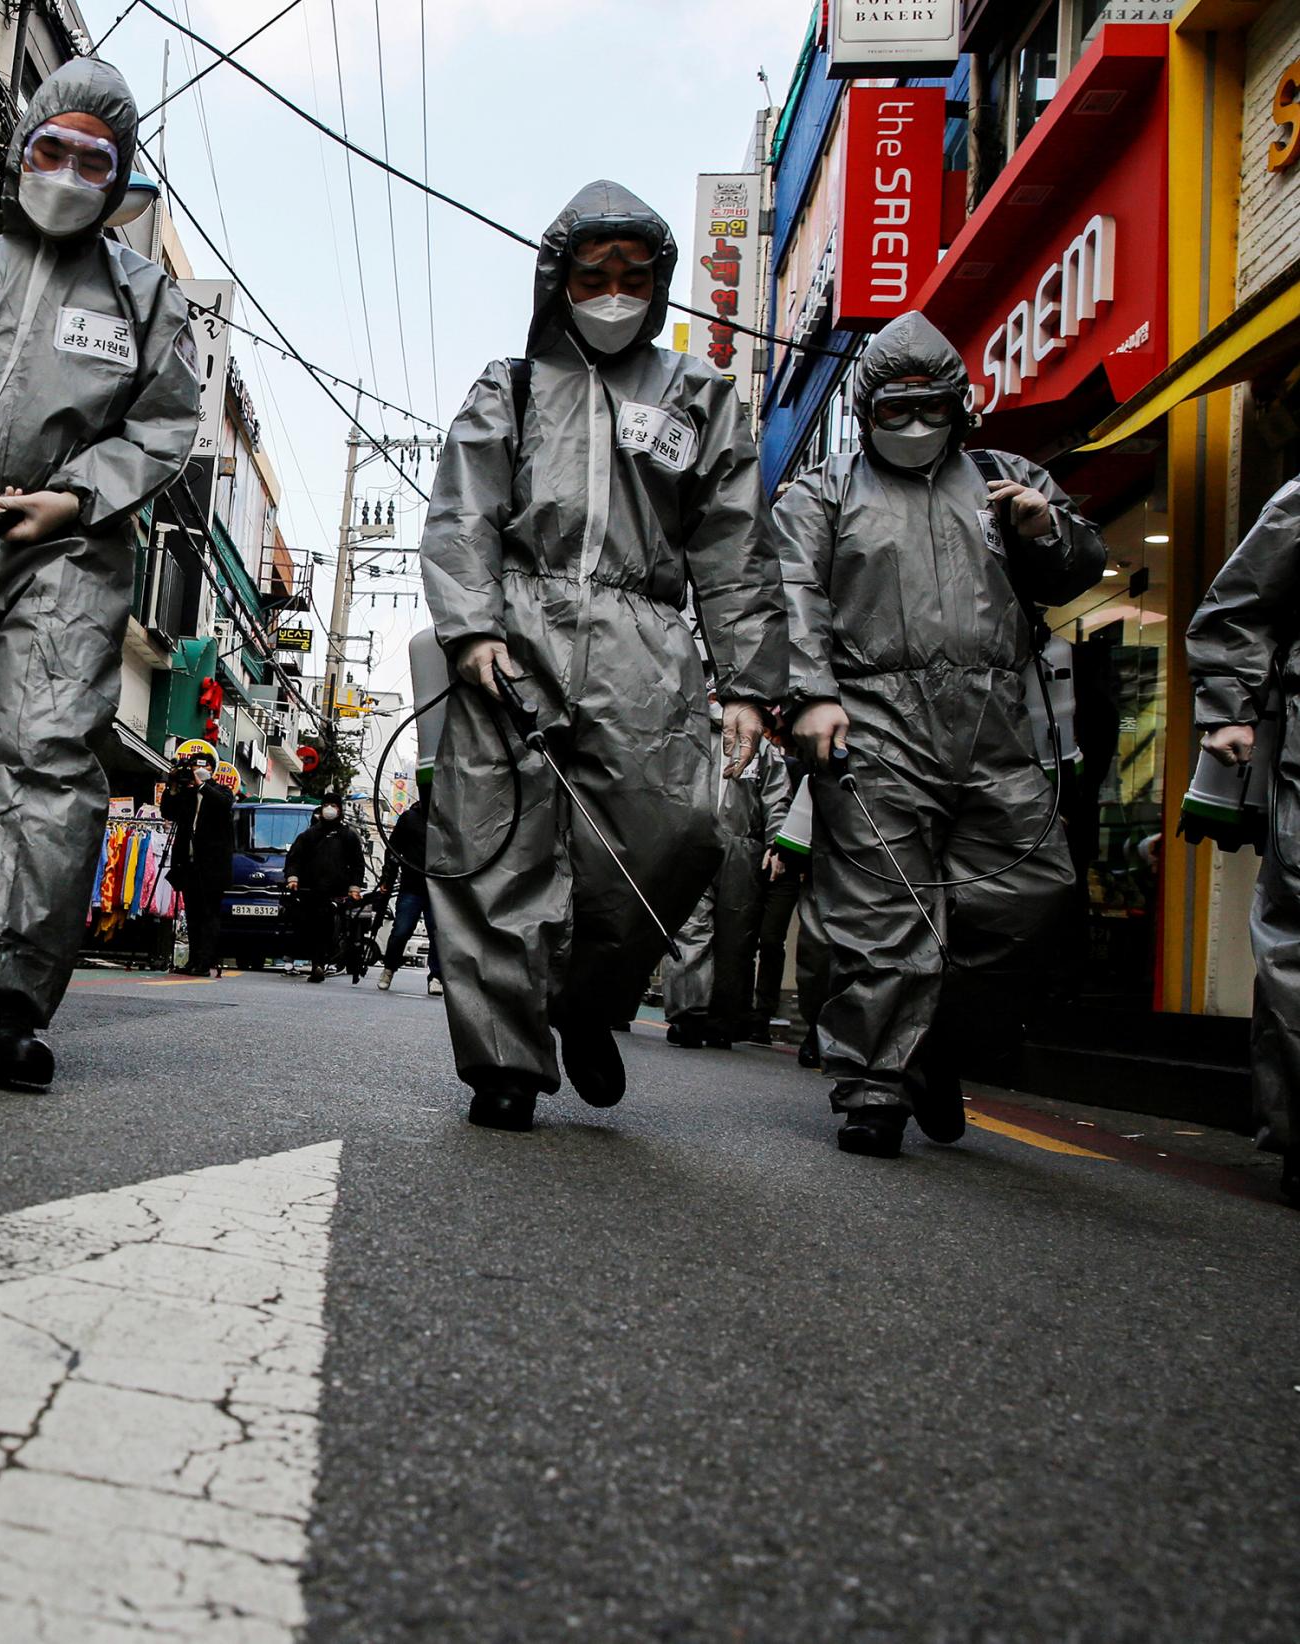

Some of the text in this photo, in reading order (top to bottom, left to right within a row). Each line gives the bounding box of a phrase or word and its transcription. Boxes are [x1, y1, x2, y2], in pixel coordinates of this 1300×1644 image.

[856, 10, 936, 21] BAKERY
[876, 102, 915, 157] the
[710, 208, 748, 217] 도깨비
[709, 219, 747, 237] 코인
[70, 316, 129, 342] 육 군
[63, 333, 130, 358] 현장 지원팀
[632, 411, 682, 447] 육 군
[199, 437, 213, 448] 2F
[622, 427, 680, 463] 현장 지원팀
[254, 906, 275, 915] 8312
